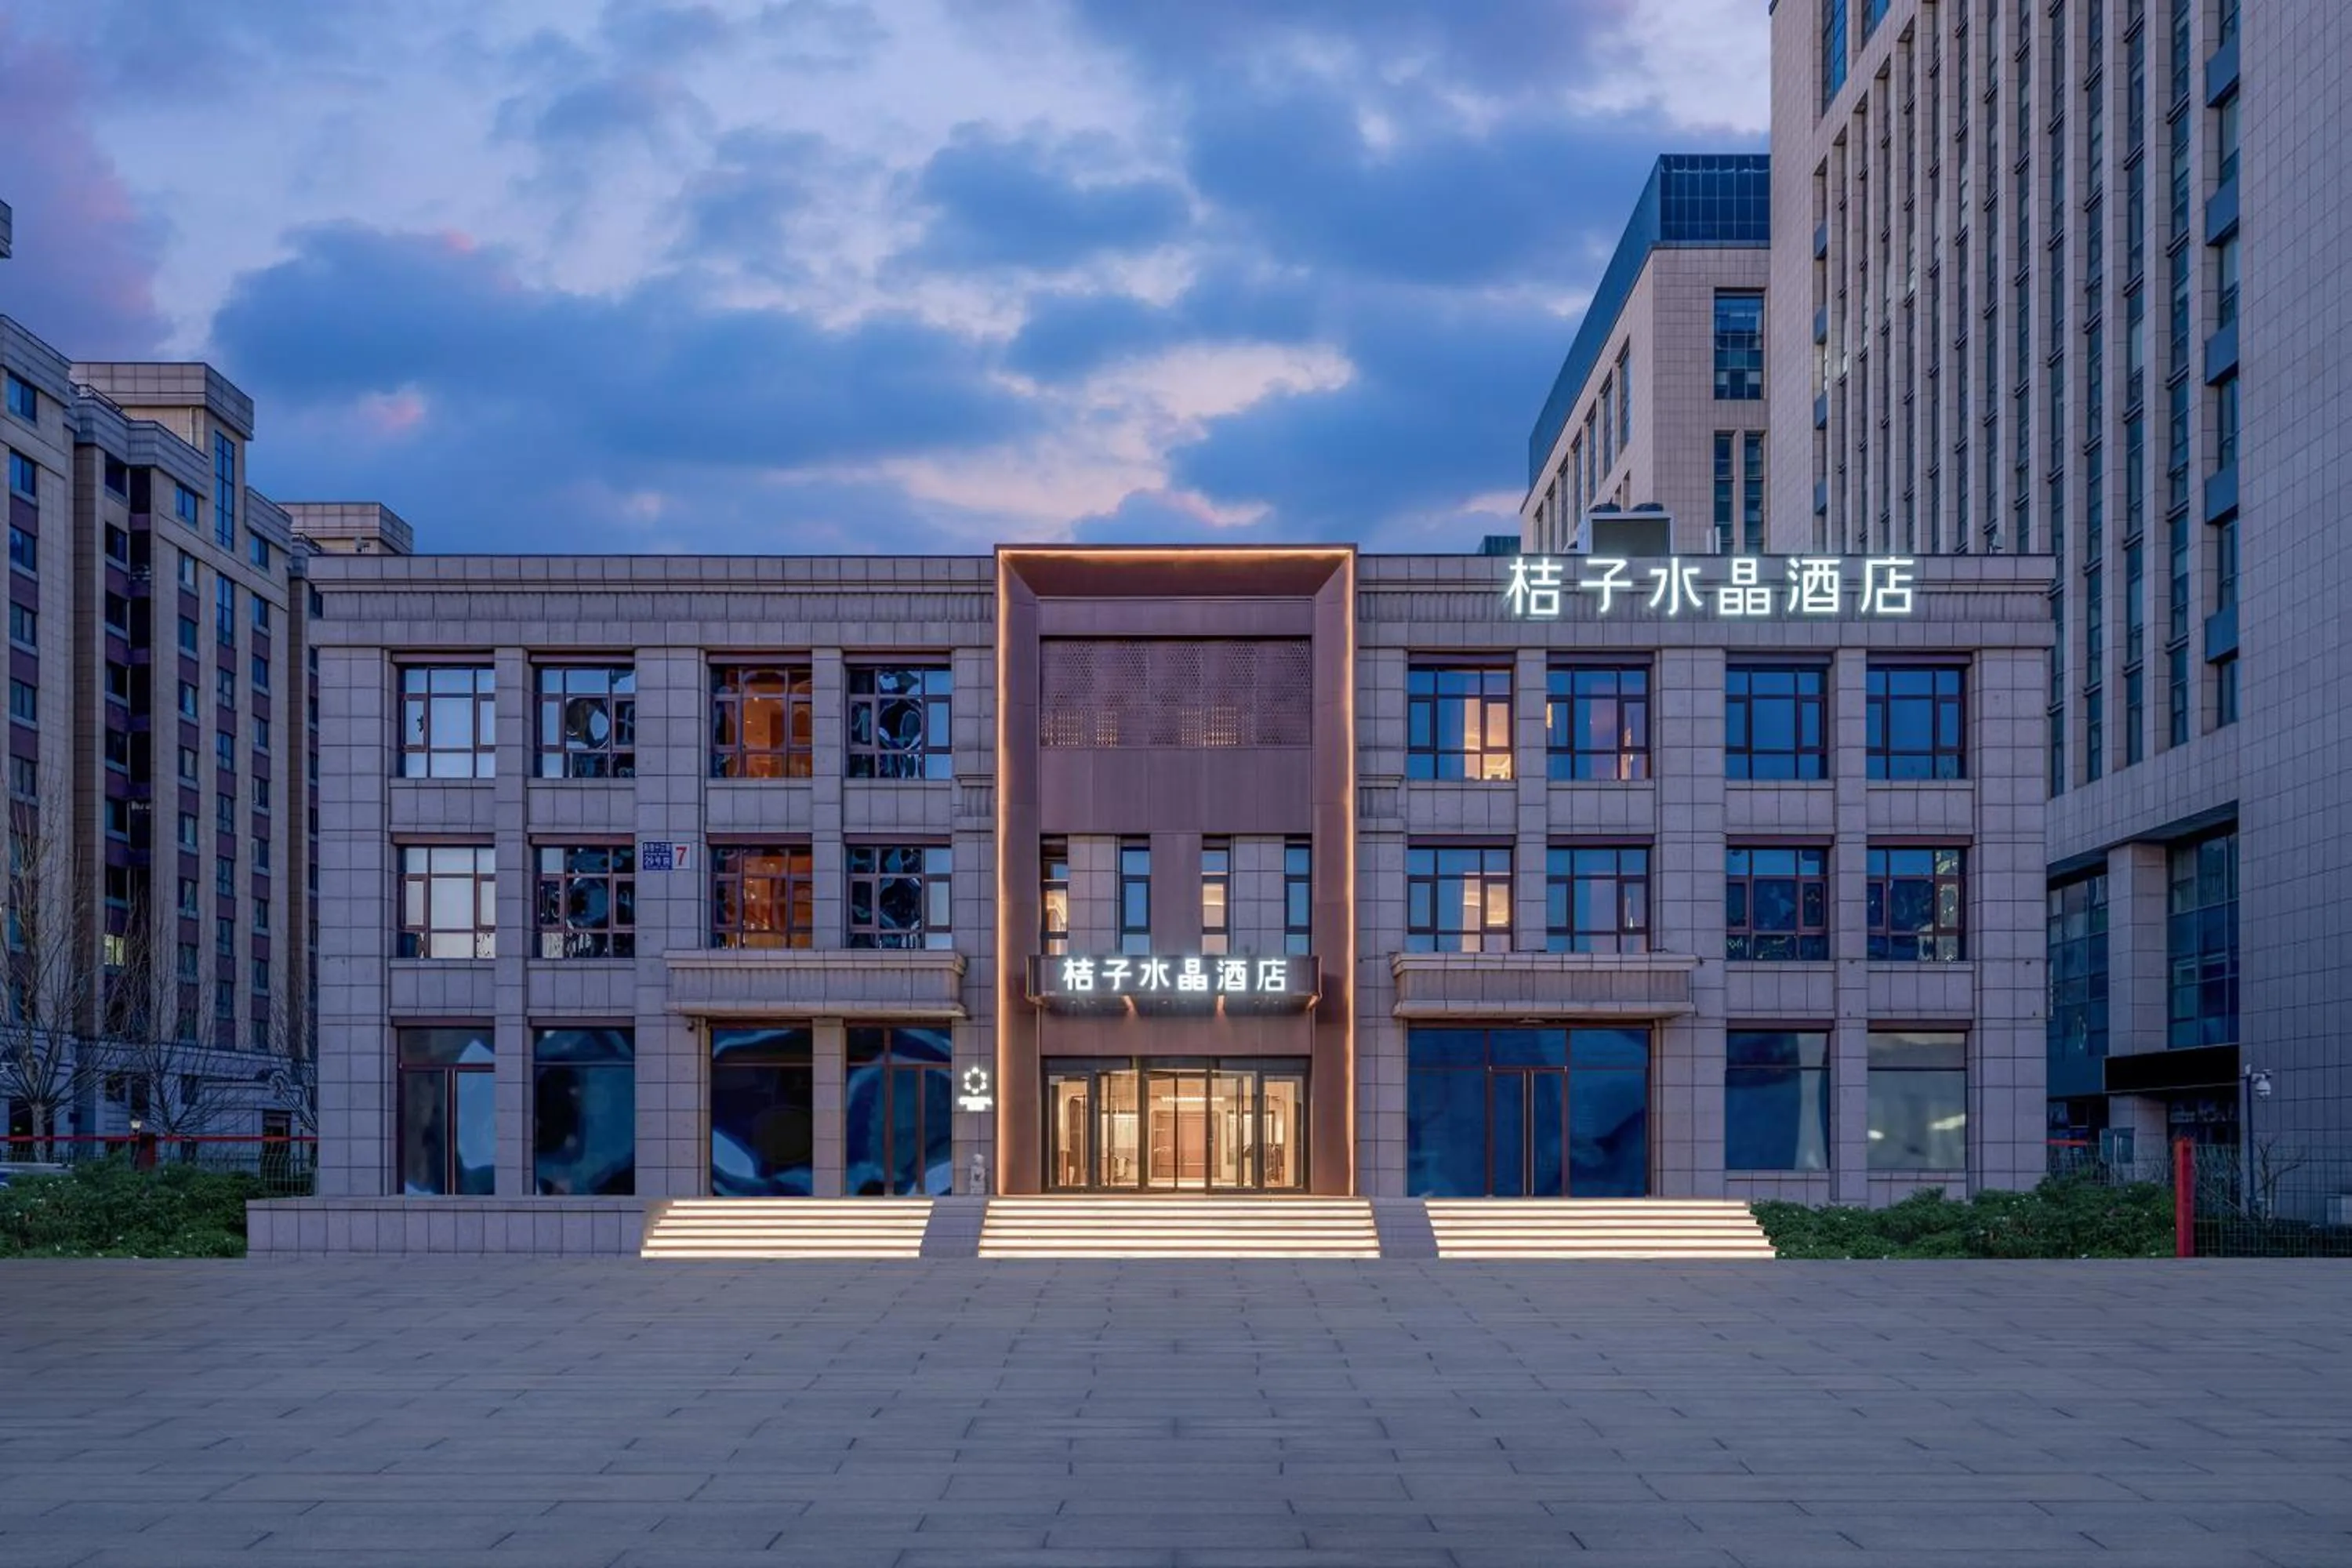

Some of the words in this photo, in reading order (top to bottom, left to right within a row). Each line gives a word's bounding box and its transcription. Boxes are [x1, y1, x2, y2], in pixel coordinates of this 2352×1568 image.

[1507, 557, 1914, 615] 桔子水晶酒店
[676, 847, 688, 866] 7
[1062, 958, 1287, 991] 桔子水晶酒店
